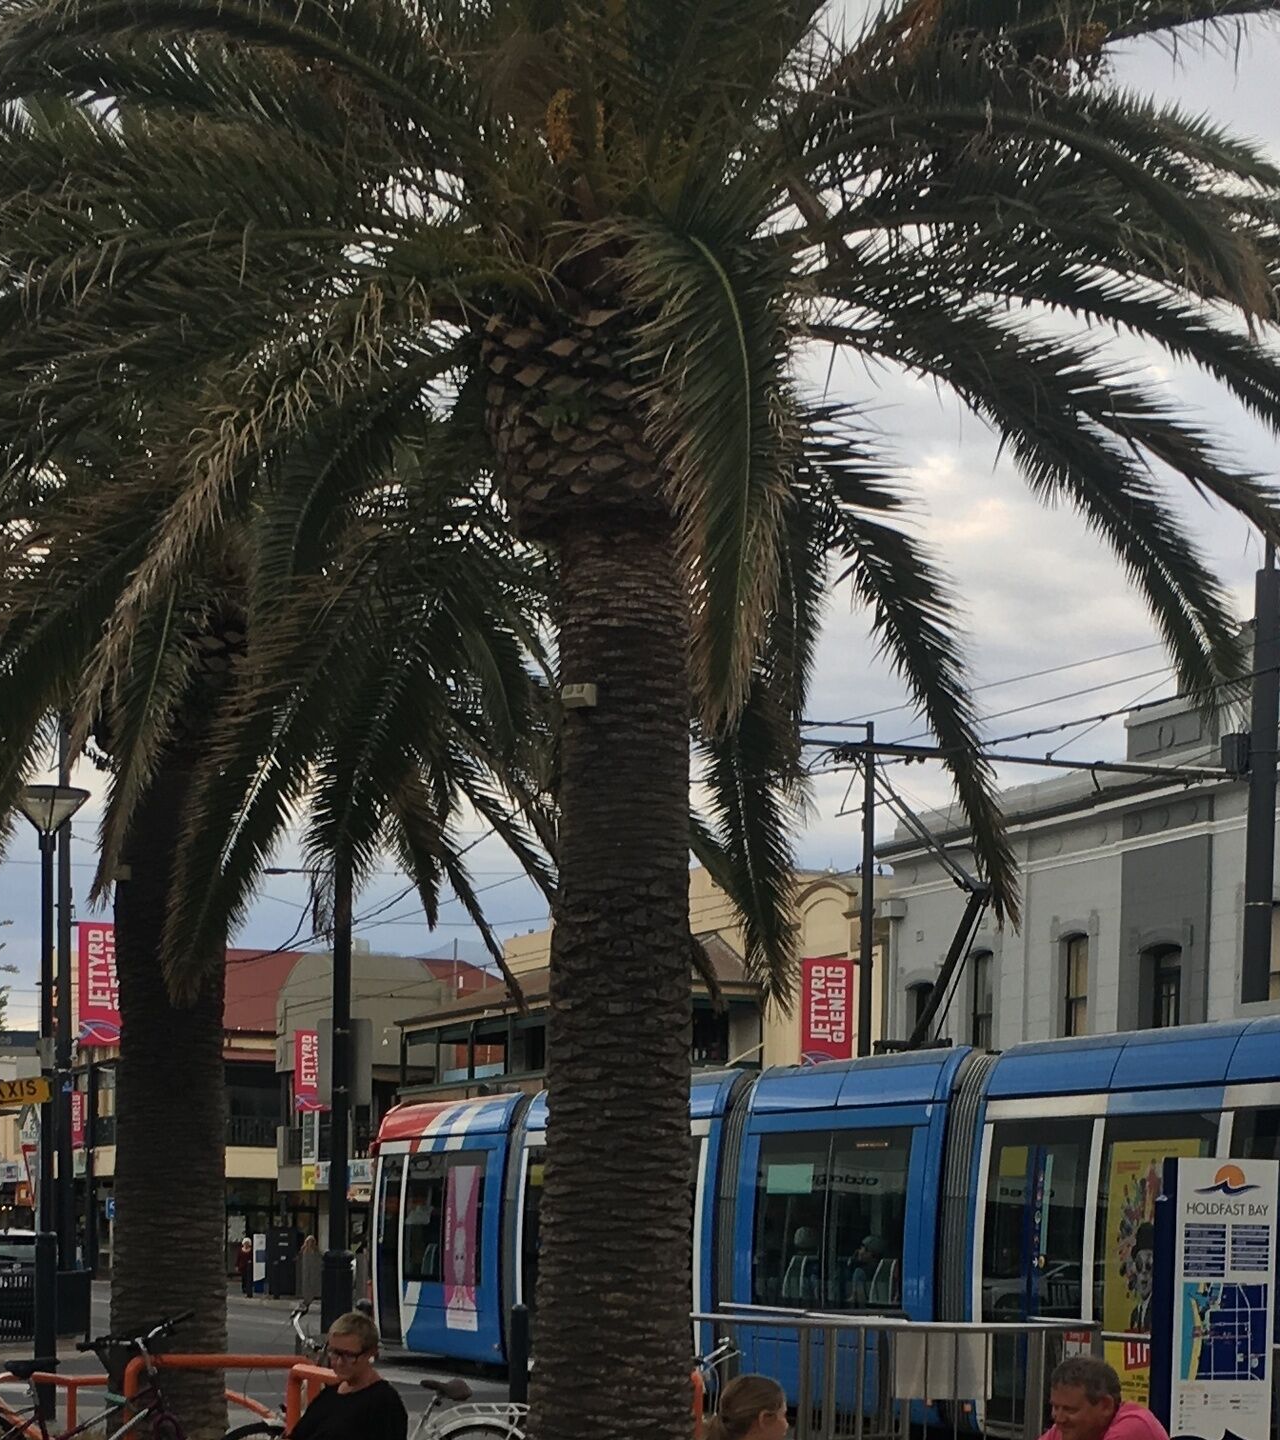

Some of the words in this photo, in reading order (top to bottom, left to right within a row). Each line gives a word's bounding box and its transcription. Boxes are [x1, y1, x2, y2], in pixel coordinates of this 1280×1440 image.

[826, 966, 847, 1043] GLENELG
[1186, 1202, 1246, 1216] HOLDFAST
[1248, 1203, 1269, 1217] BAY
